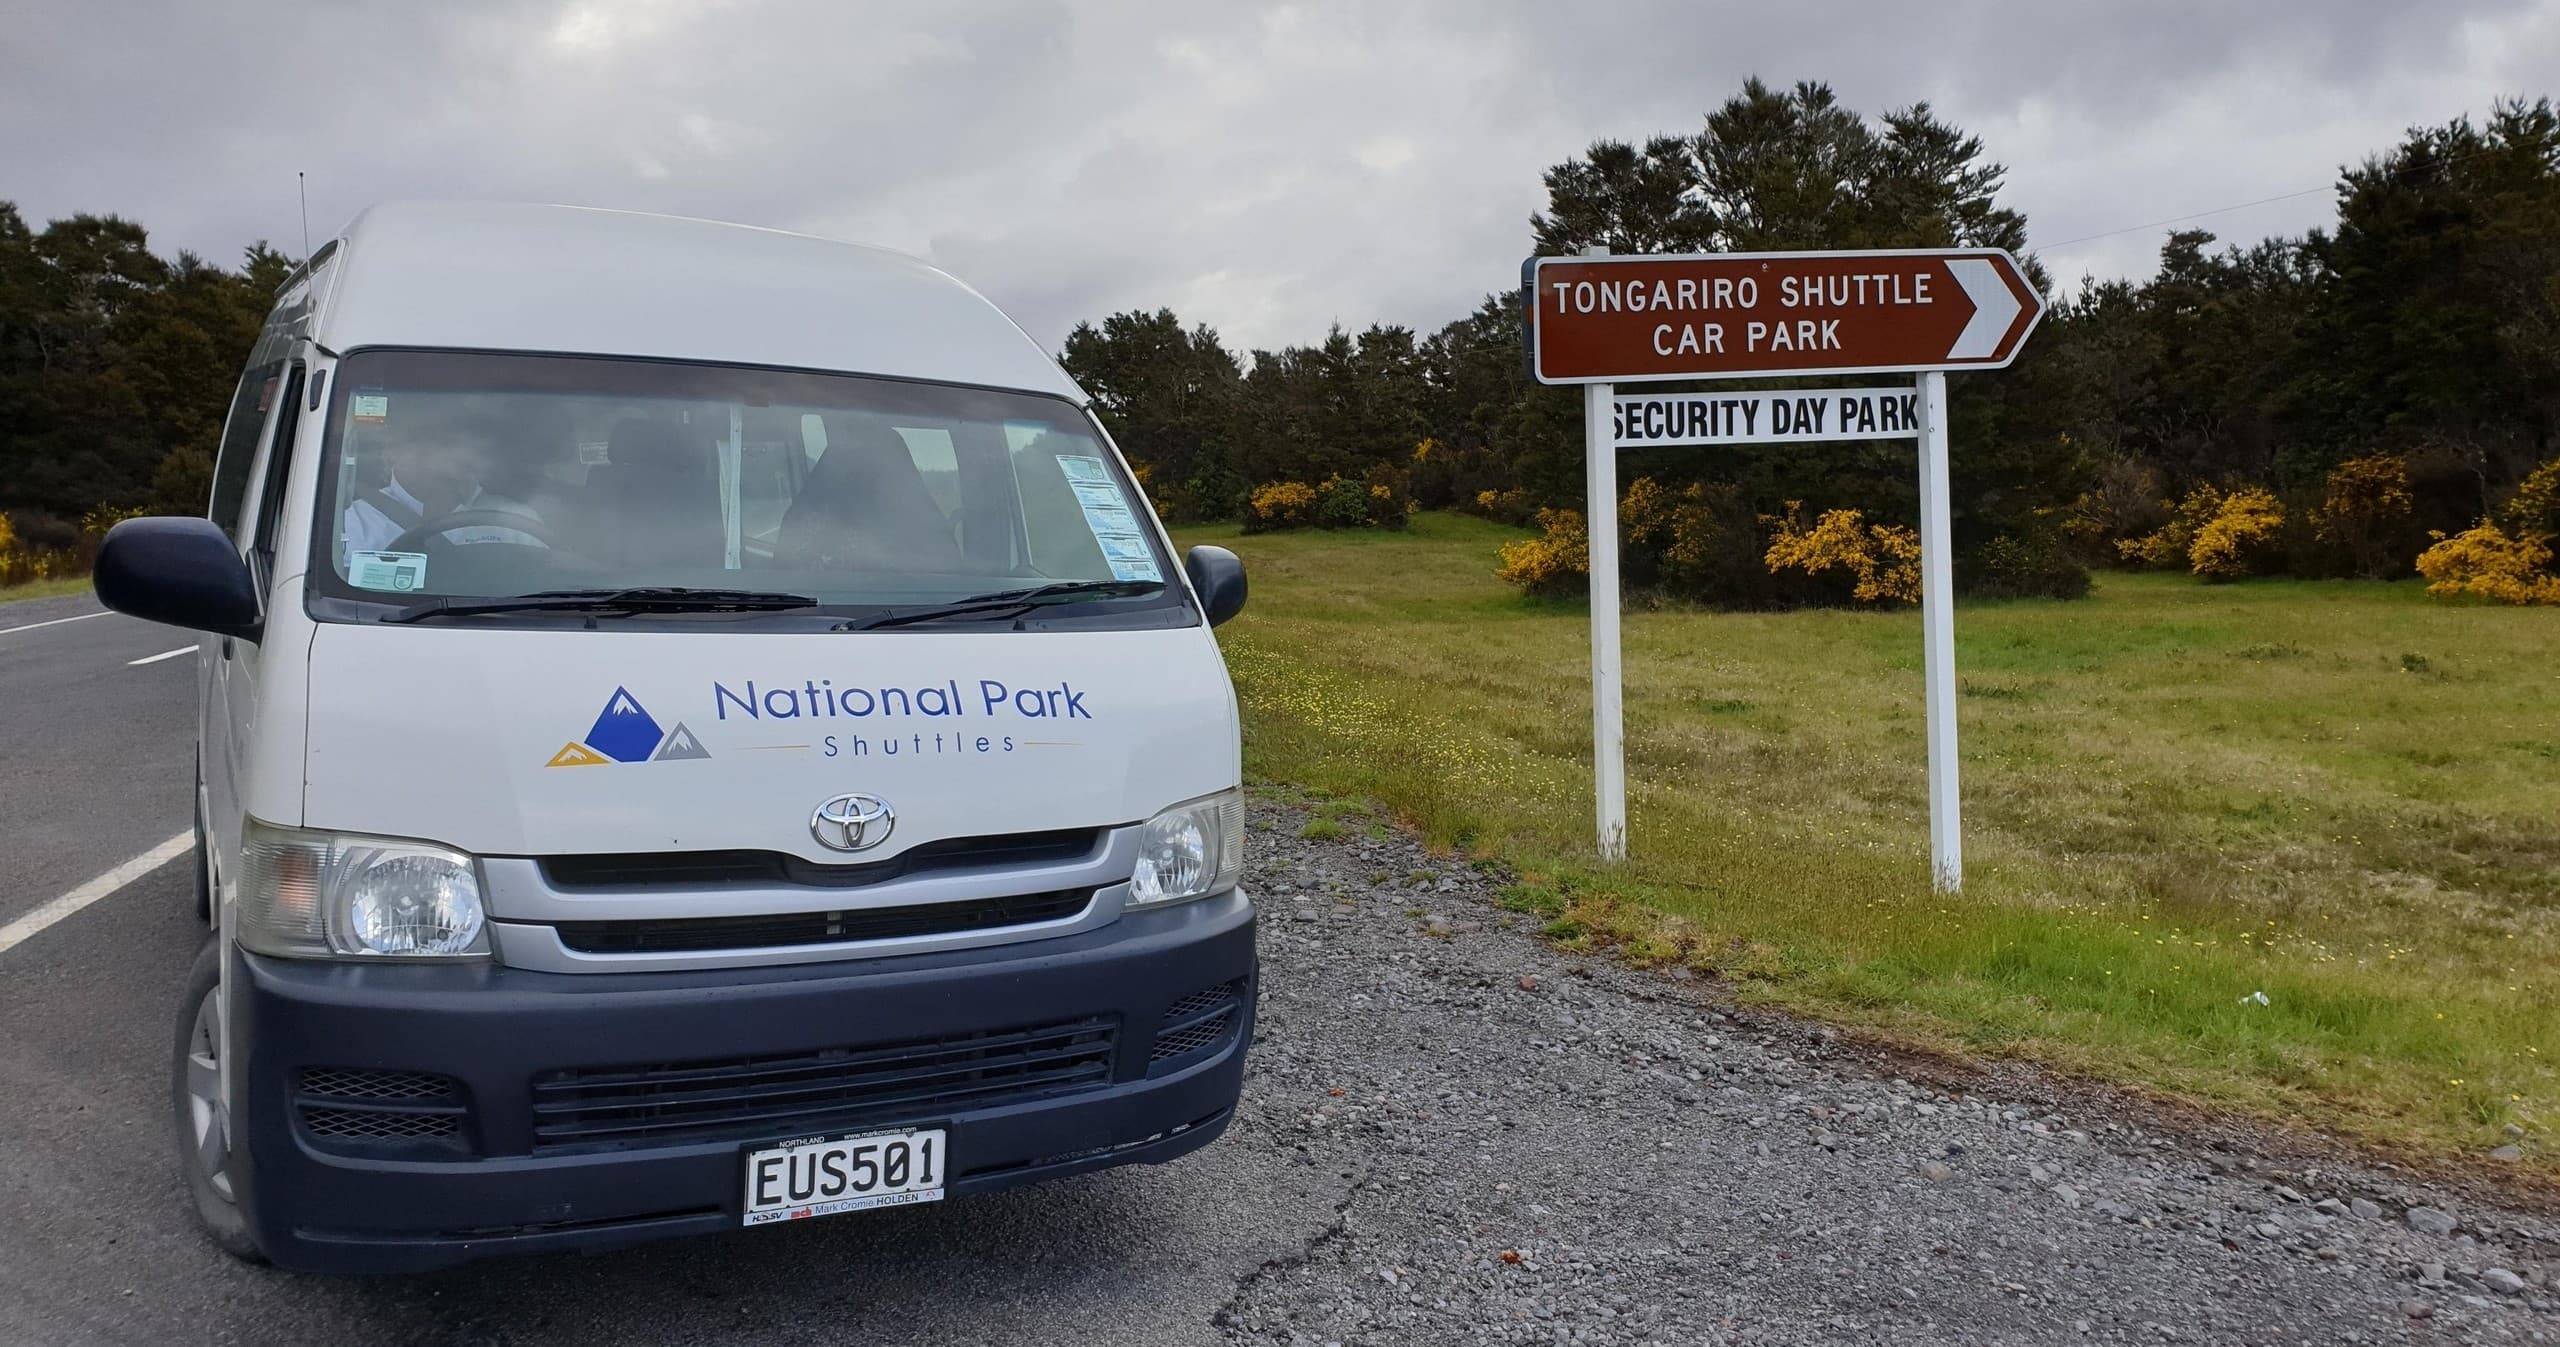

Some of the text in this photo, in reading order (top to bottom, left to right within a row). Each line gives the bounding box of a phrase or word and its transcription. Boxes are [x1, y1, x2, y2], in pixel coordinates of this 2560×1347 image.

[1553, 273, 1934, 314] TONGARIRO SHUTTLE
[1653, 319, 1841, 356] CAR PARK
[1772, 398, 1828, 435] DAY
[1840, 395, 1919, 433] PARK
[714, 680, 1093, 721] National Park
[824, 732, 1014, 758] Shuttles
[779, 1126, 917, 1148] NORTHLAND www.markcromie.com
[756, 1138, 933, 1206] EUS501
[815, 1204, 839, 1214] Mark
[840, 1199, 874, 1211] Cromie
[876, 1193, 919, 1206] HOLDEN
